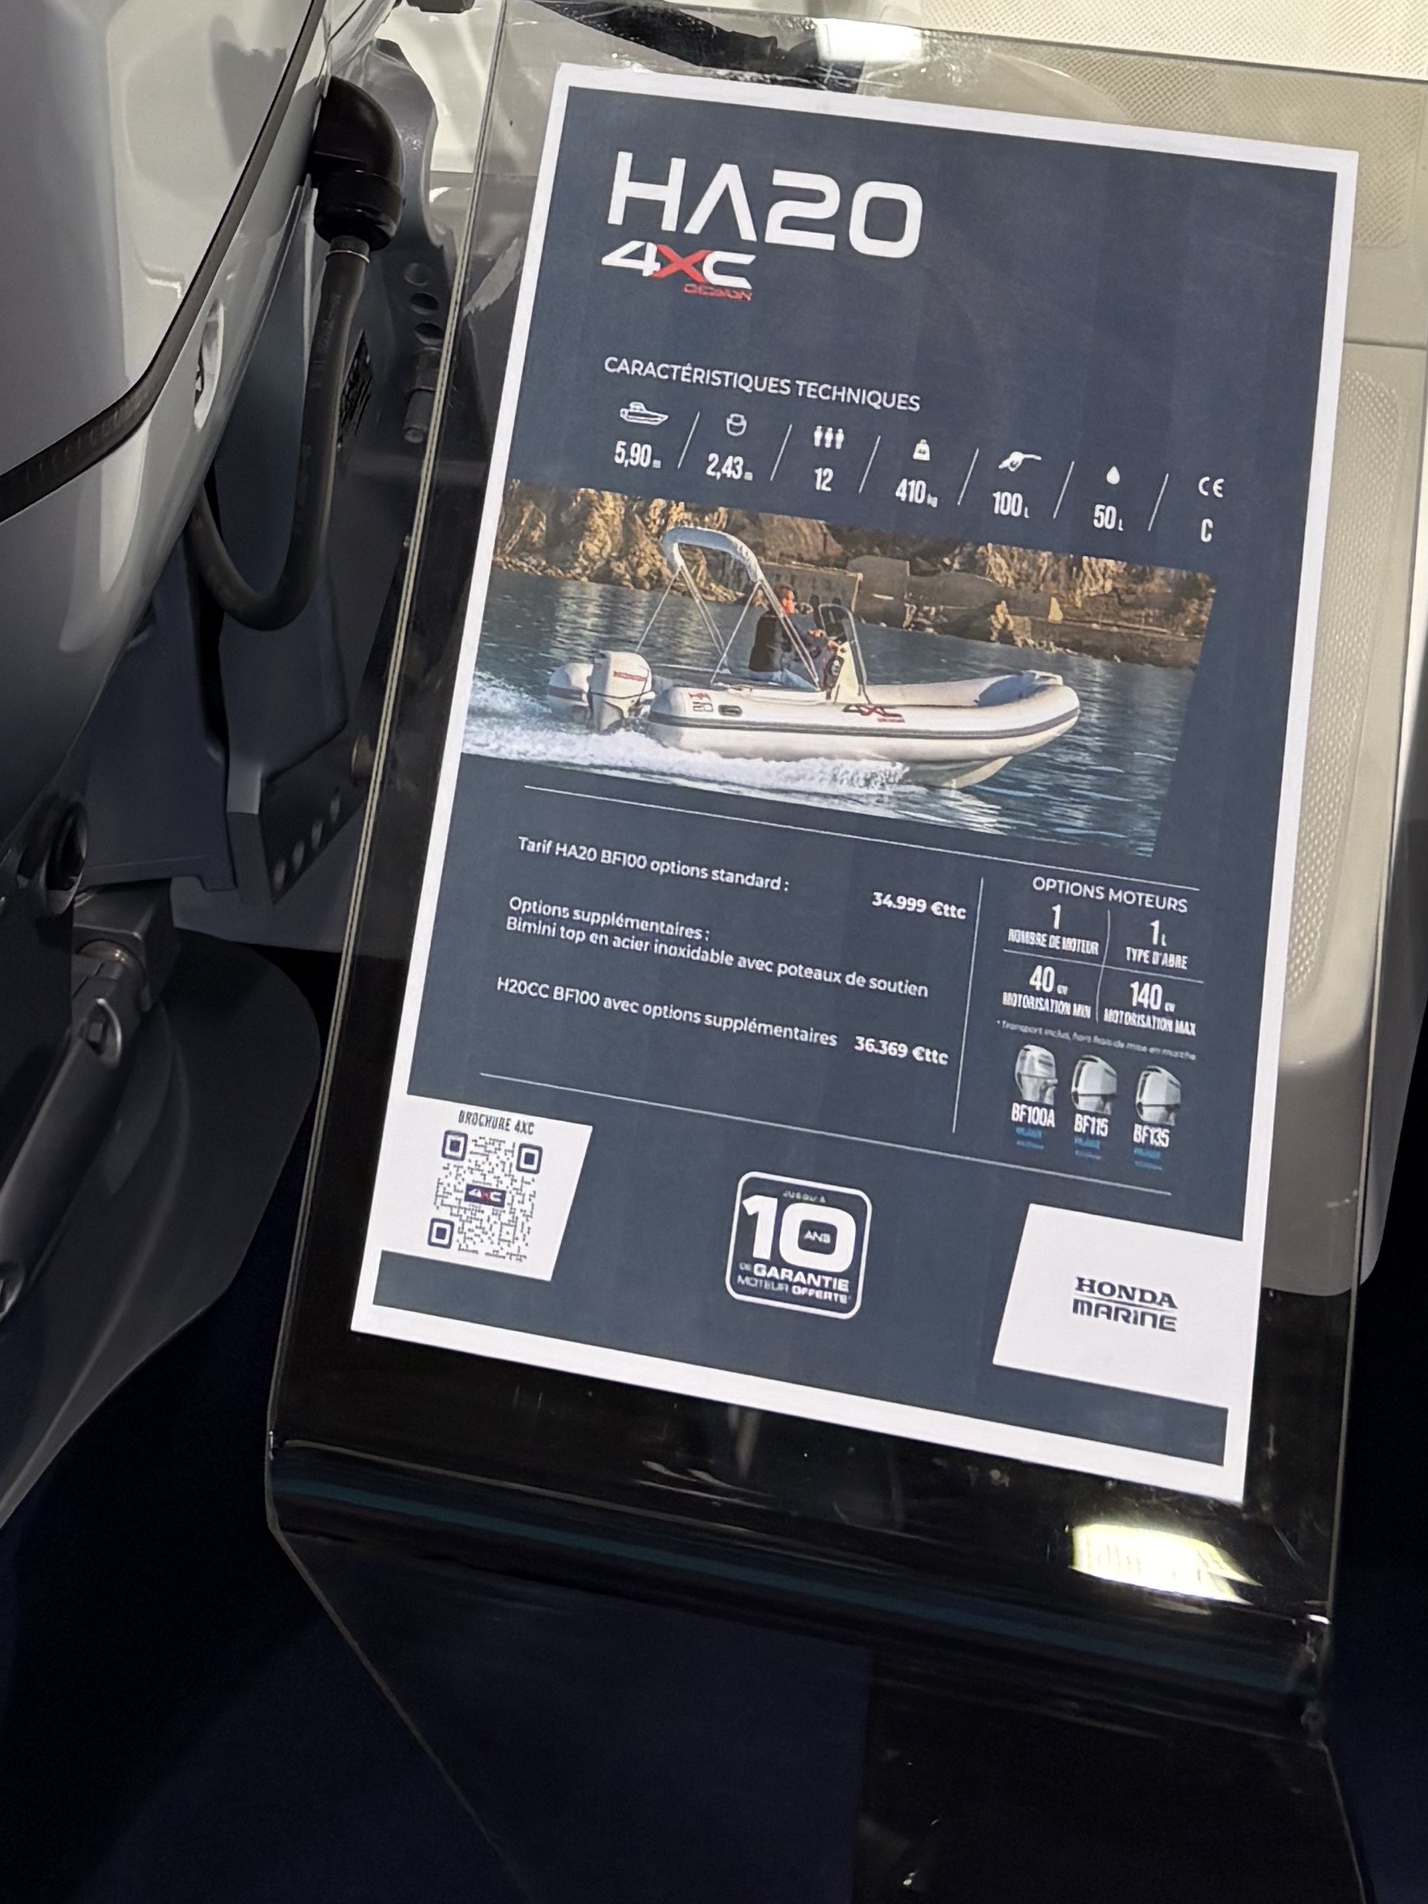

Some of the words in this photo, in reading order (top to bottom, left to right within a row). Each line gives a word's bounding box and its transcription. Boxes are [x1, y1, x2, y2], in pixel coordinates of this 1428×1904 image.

[607, 150, 923, 259] HA20
[601, 240, 757, 291] 4XC
[604, 355, 792, 395] CARACTÉRISTIQUES
[795, 379, 921, 412] TECHNIQUES
[814, 467, 835, 492] 12
[1200, 517, 1214, 543] C
[518, 835, 553, 855] Tarif
[554, 842, 597, 862] HA20
[600, 848, 648, 870] BF100
[649, 859, 709, 880] options
[710, 867, 782, 891] standard
[871, 890, 928, 914] 34.999
[930, 900, 967, 920] €ttc
[1032, 876, 1105, 900] OPTIONS
[1108, 888, 1189, 914] MOTEURS
[508, 895, 570, 920] Options
[572, 906, 703, 941] supplémentaires
[1051, 903, 1062, 930] 1
[505, 915, 557, 938] Bimini
[559, 925, 586, 944] top
[589, 932, 609, 946] en
[612, 934, 651, 953] acier
[653, 938, 735, 967] inoxidable
[737, 955, 774, 973] avec
[776, 961, 842, 985] poteaux
[844, 971, 867, 988] de
[868, 976, 929, 998] soutien
[1061, 935, 1100, 956] MOTEUR
[1125, 946, 1150, 966] TYPE
[496, 976, 550, 999] H20CC
[552, 985, 601, 1008] BF100
[603, 996, 640, 1014] avec
[642, 1000, 702, 1025] options
[703, 1012, 838, 1047] supplémentaires
[853, 1035, 909, 1059] 36.369
[911, 1045, 950, 1066] €ttc
[1001, 991, 1071, 1017] MOTORISATION
[1072, 1001, 1092, 1020] MIN
[1103, 1007, 1173, 1033] MOTORISATION
[1174, 1019, 1197, 1037] MAX
[458, 1109, 512, 1133] BROCHURE
[513, 1118, 536, 1136] 4XC
[1010, 1101, 1056, 1129] BF100A
[1073, 1112, 1110, 1138] BF115
[1132, 1123, 1171, 1149] BF135
[741, 1193, 857, 1274] 10
[736, 1274, 790, 1293] MOTEUR
[753, 1262, 850, 1293] GARANTIE
[1074, 1275, 1179, 1310] HONDA
[1072, 1297, 1178, 1333] MARINE
